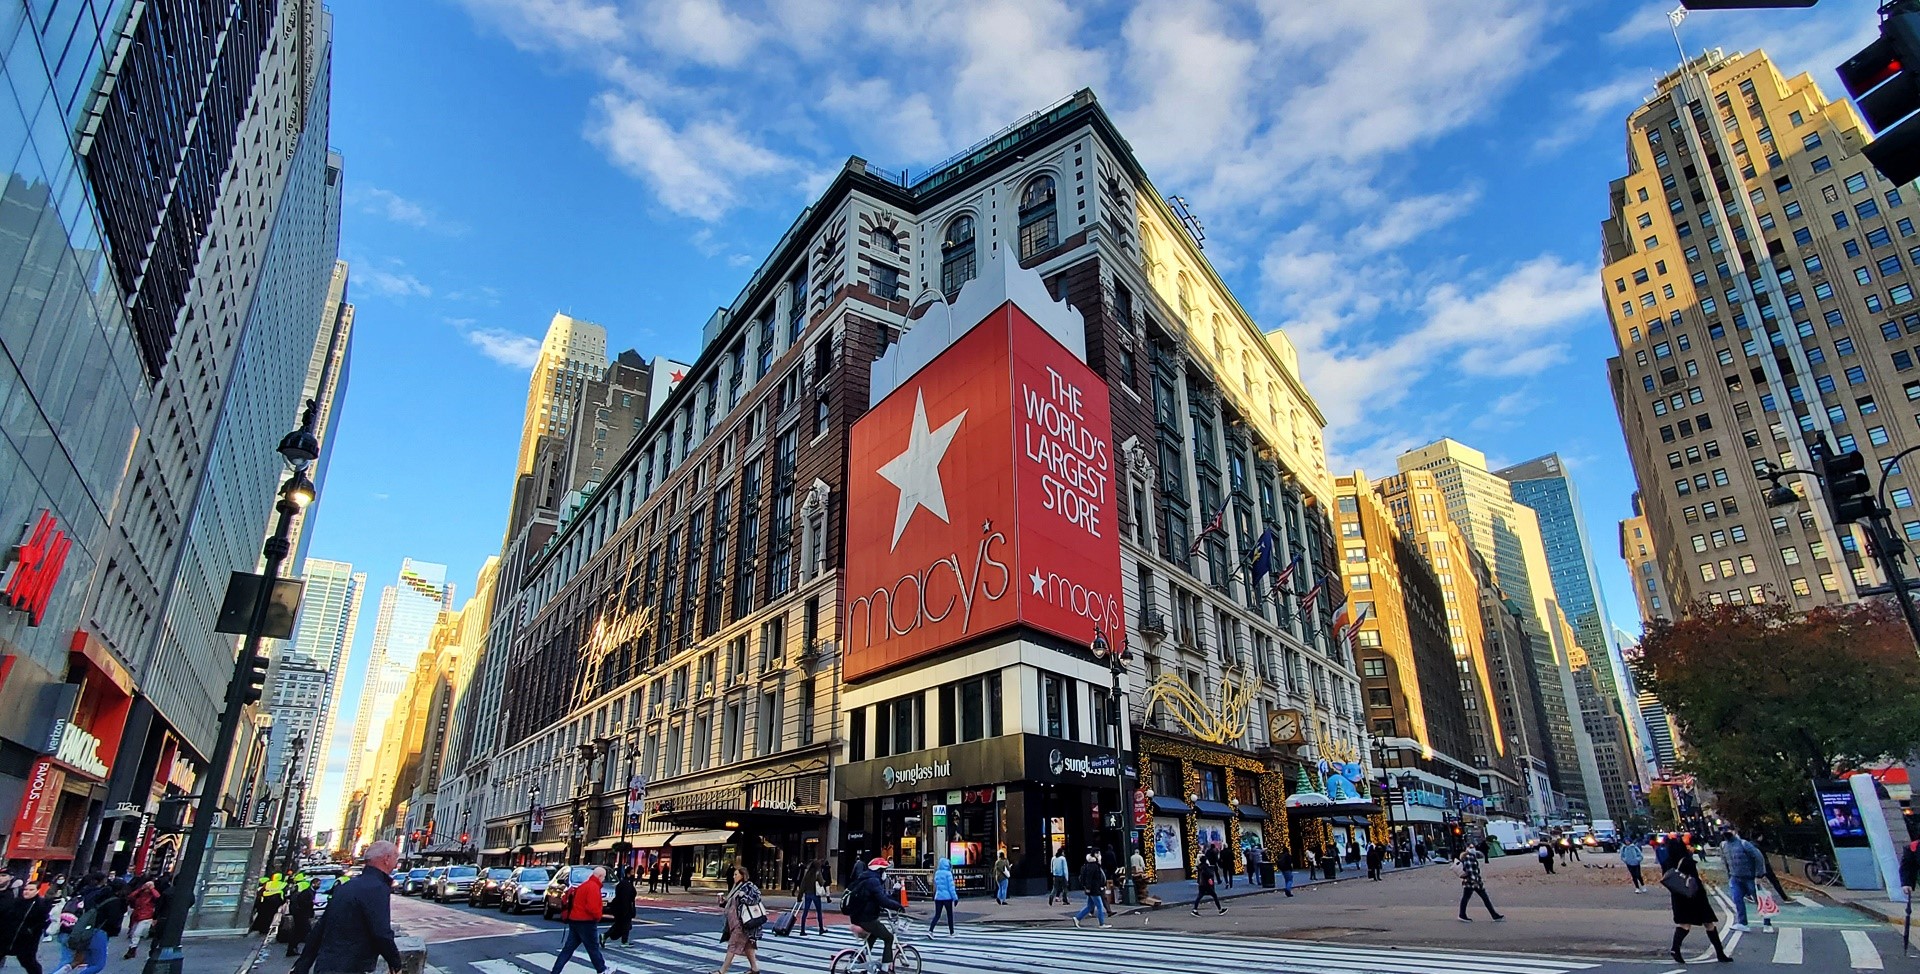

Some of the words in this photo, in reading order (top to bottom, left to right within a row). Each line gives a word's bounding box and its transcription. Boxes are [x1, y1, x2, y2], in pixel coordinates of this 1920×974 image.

[1046, 366, 1084, 421] THE
[1022, 384, 1108, 470] WORLD'S
[1025, 422, 1107, 504] LARGEST
[1041, 474, 1101, 538] STORE
[847, 518, 1010, 655] macy's
[1048, 571, 1119, 633] macy's
[48, 718, 65, 752] verizon
[29, 762, 50, 800] FAMOUS
[895, 763, 933, 786] sunglass
[934, 760, 951, 778] hut
